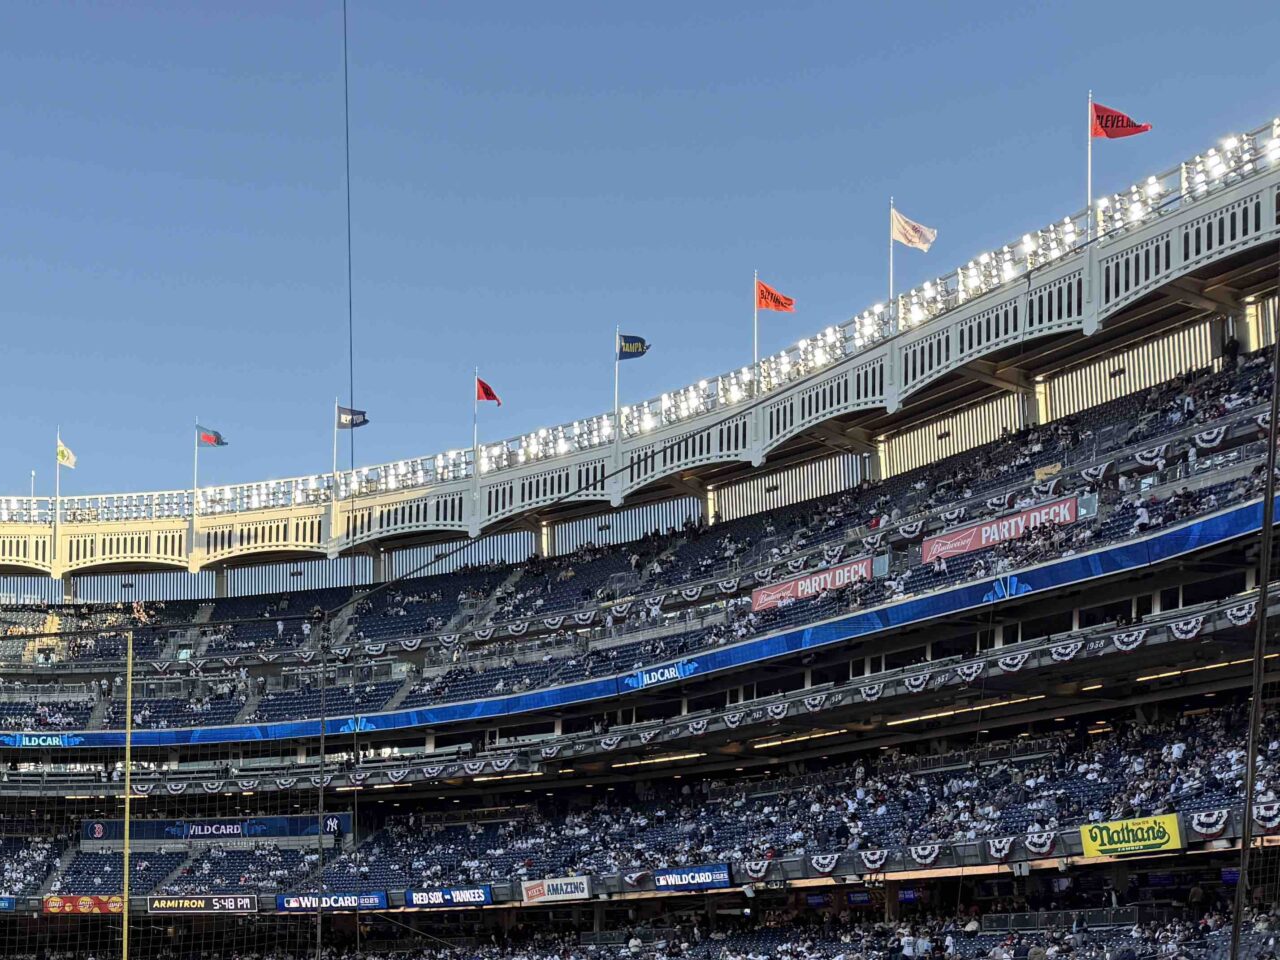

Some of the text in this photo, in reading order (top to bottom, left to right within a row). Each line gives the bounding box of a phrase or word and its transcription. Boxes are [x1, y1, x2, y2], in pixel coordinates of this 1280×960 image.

[981, 502, 1070, 544] PARTY DECK
[798, 562, 867, 596] PARTY DECK
[1088, 820, 1171, 847] Nathan's
[413, 890, 484, 904] RED SOX YANKEES
[547, 881, 585, 896] AMAZING
[153, 899, 250, 909] ARMITRON 5:48 PM
